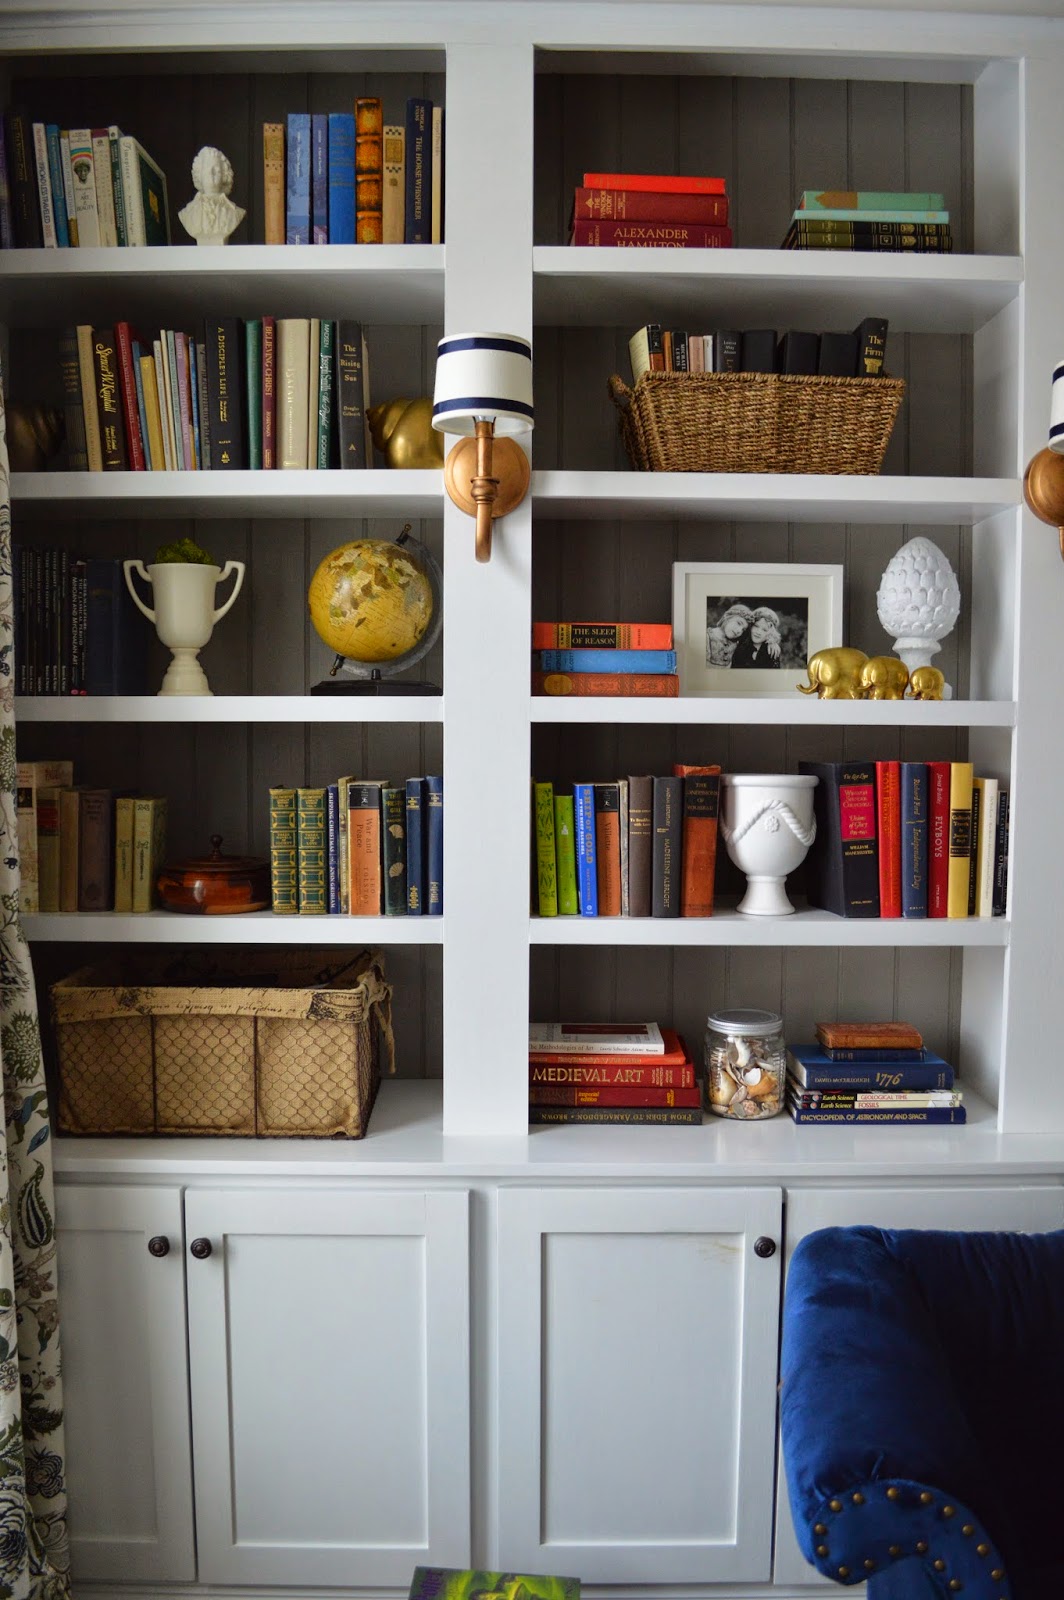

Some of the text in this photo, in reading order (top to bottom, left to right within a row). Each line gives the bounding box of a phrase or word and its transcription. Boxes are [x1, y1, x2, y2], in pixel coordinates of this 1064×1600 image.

[123, 143, 132, 179] Timepiece
[41, 184, 49, 196] LESS
[614, 228, 688, 239] ALEXANDER
[120, 334, 128, 366] CHRISTMAS
[343, 344, 356, 352] The
[864, 347, 883, 357] Firm
[868, 335, 883, 345] The
[95, 343, 112, 372] Spencer
[218, 335, 226, 376] DISCIPLE'S
[265, 326, 273, 397] BELIEVING CHRIST
[320, 353, 332, 374] Joseph
[340, 359, 360, 369] Rising
[99, 382, 116, 413] Kimball
[179, 380, 188, 413] CELESTIAL
[219, 378, 227, 395] LIFE
[286, 368, 294, 403] ISAIAH
[321, 375, 331, 391] Smith
[584, 789, 592, 818] SHIP
[356, 824, 364, 848] Peace
[585, 833, 593, 863] GOLD
[604, 822, 612, 851] Villette
[934, 816, 942, 858] FLYBOYS
[911, 828, 921, 889] Independence Day
[533, 1068, 644, 1083] MEDIEVAL ART
[876, 1072, 903, 1087] 1776
